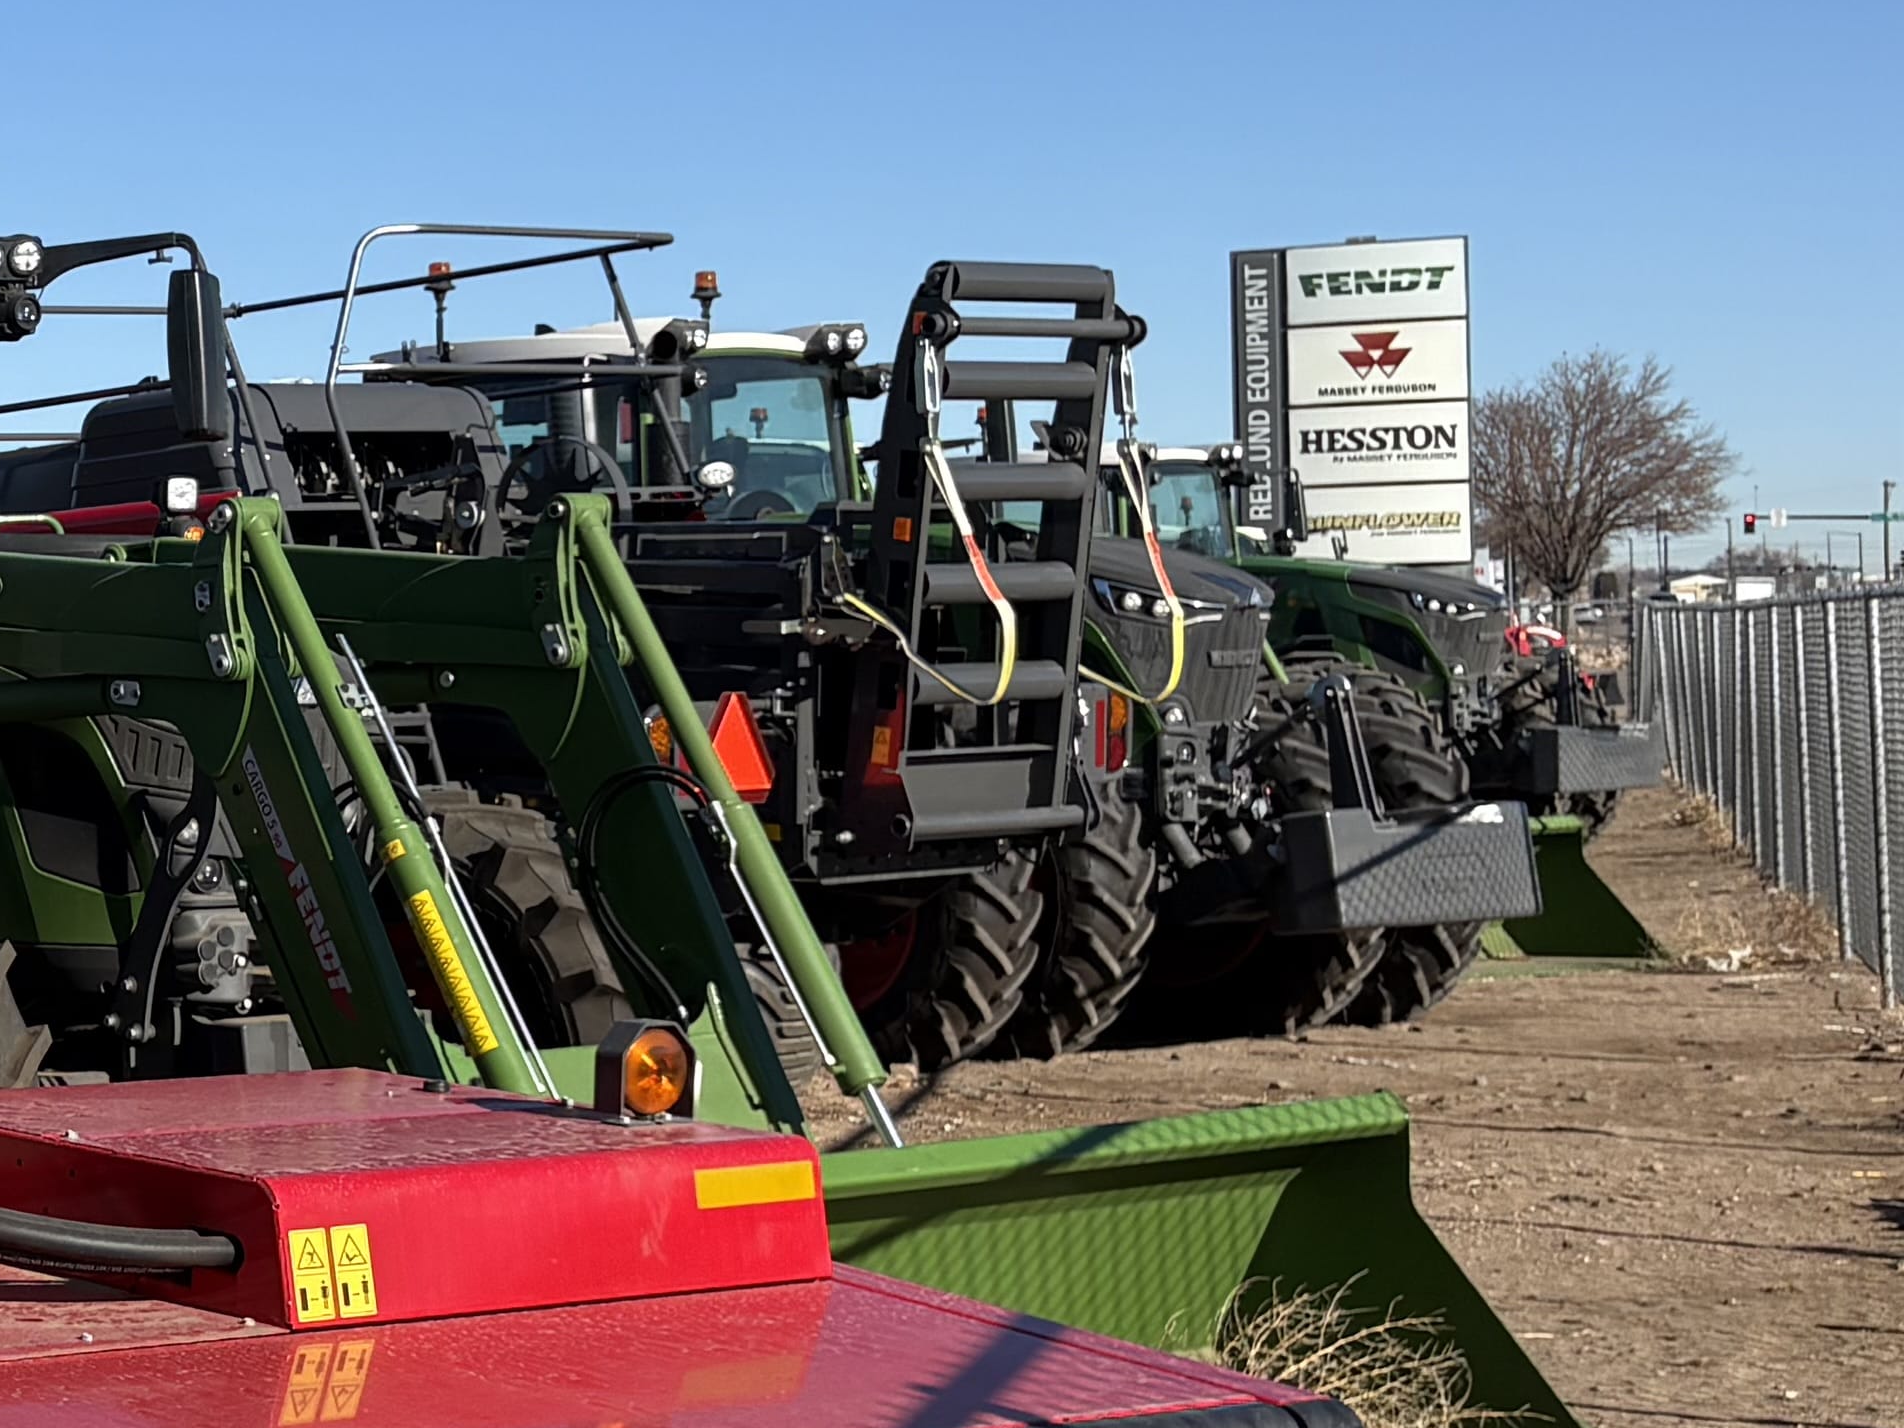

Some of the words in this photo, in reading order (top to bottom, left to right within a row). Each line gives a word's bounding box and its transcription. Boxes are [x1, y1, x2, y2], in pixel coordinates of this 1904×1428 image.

[1298, 266, 1455, 297] FENDT
[1245, 264, 1270, 403] EQUIPMENT
[1318, 387, 1367, 397] MASSEY
[1371, 383, 1437, 394] FERGUSON
[1299, 424, 1457, 454] HESSTON
[245, 759, 272, 817] CARGO
[288, 860, 352, 993] FENDT
